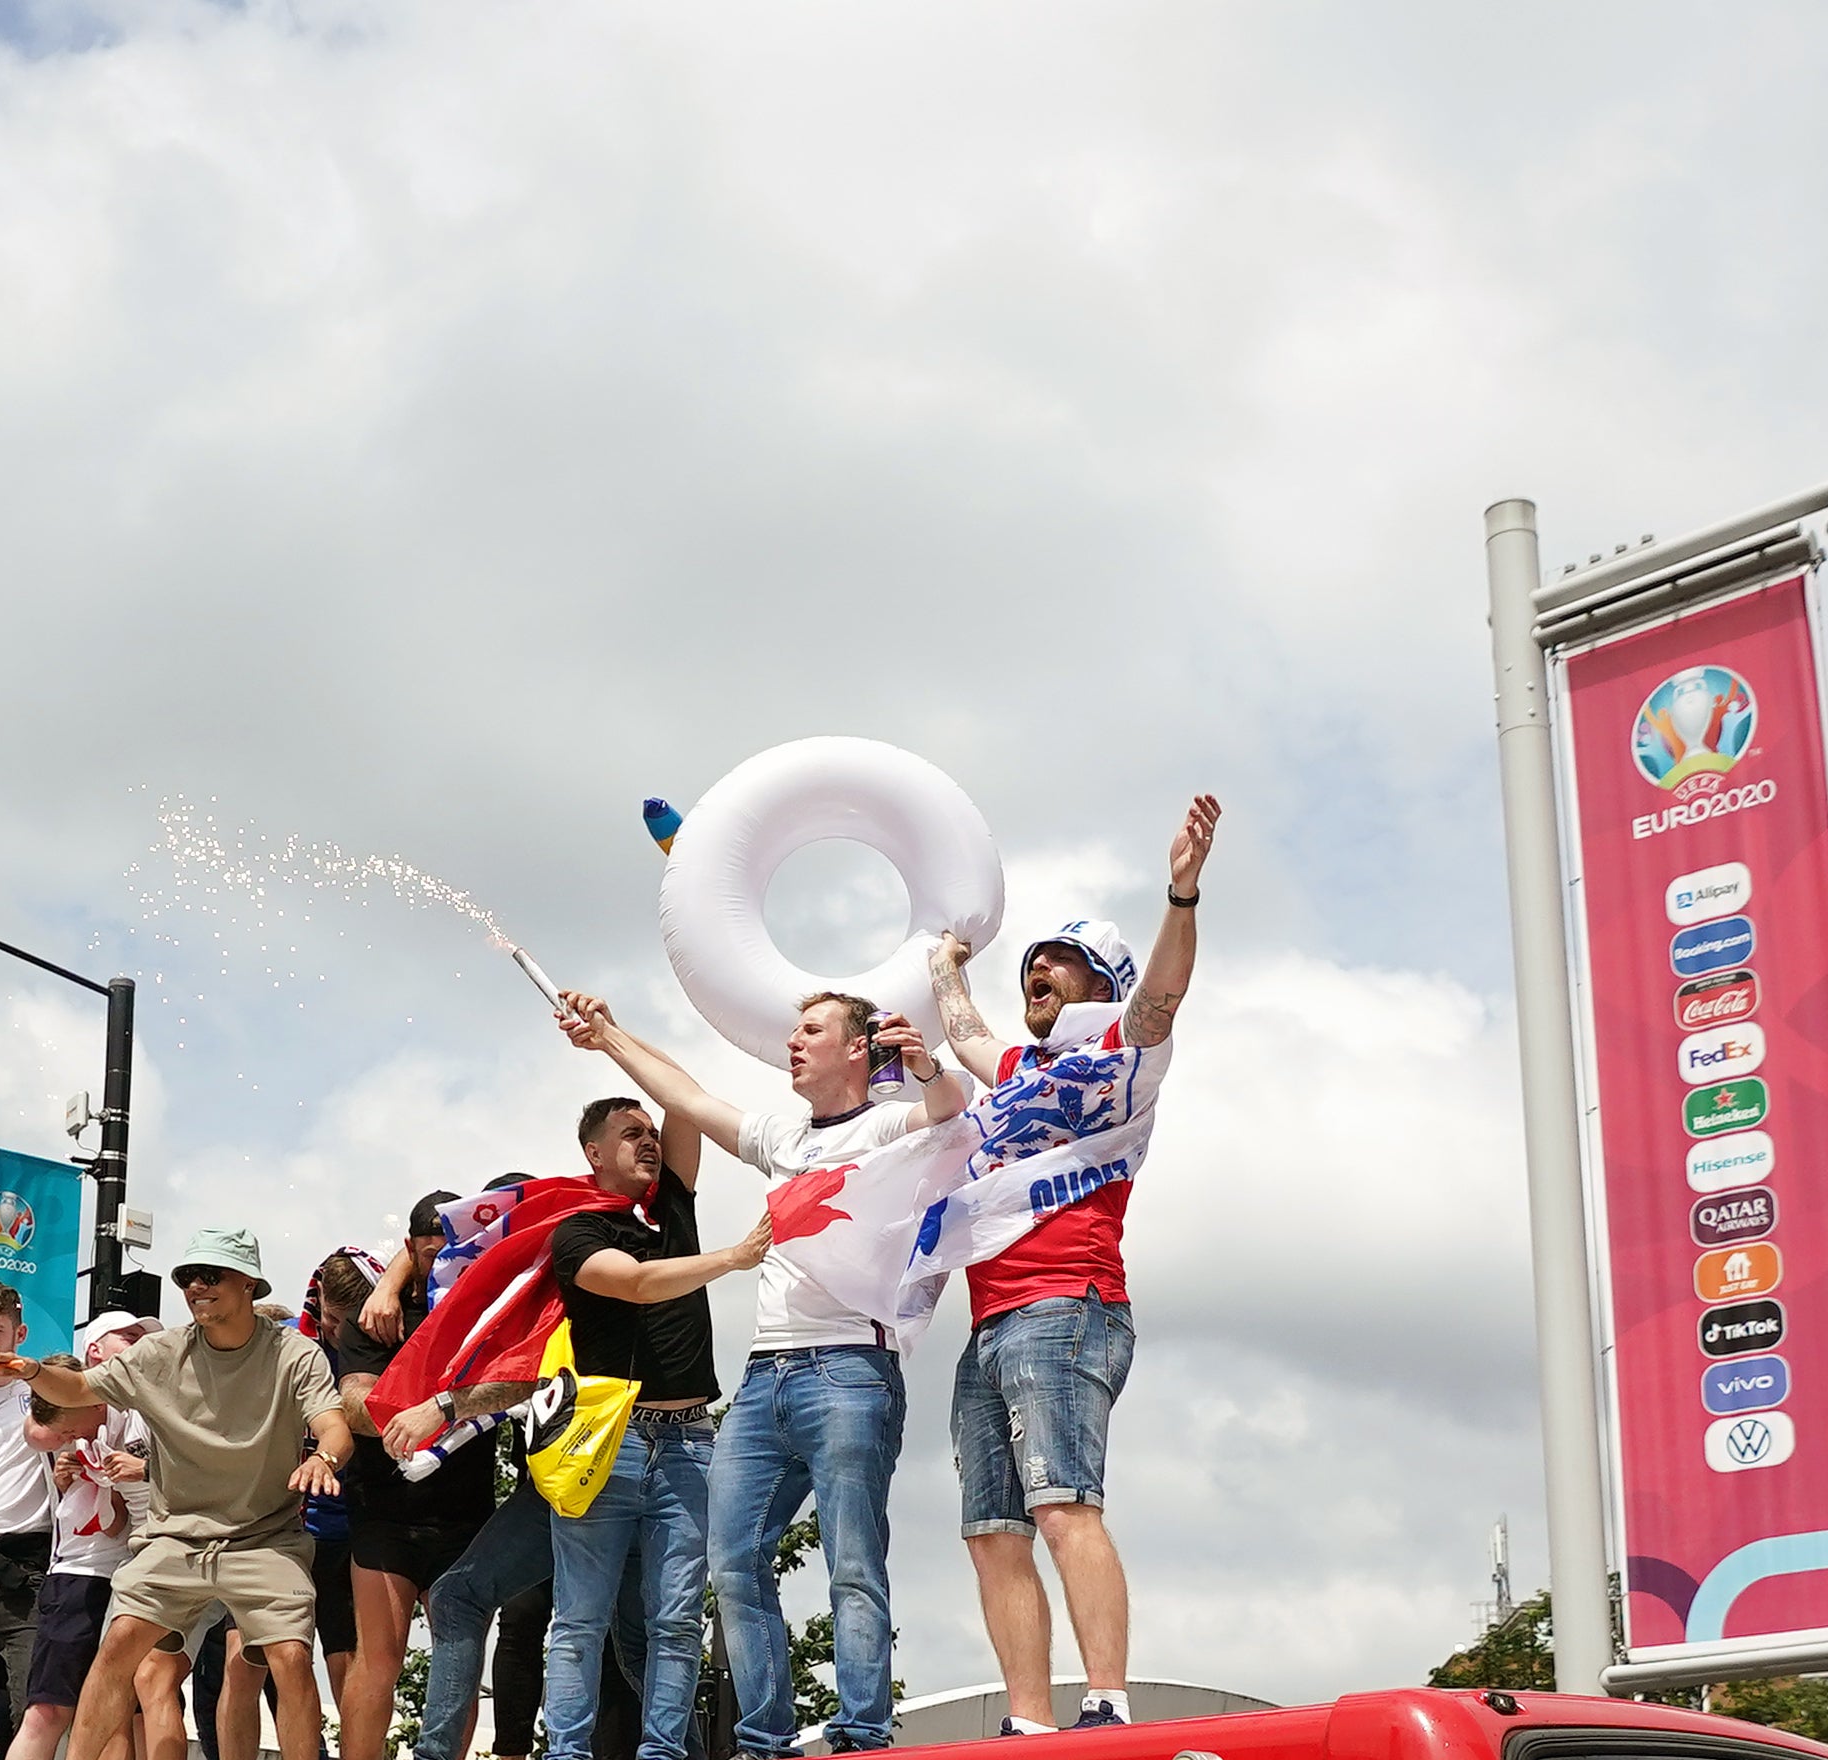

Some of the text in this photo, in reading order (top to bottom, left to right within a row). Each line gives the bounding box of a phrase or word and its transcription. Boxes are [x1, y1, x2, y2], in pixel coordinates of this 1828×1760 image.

[1673, 932, 1752, 961] Booking.com
[1689, 1041, 1752, 1069] FedEx
[1692, 1103, 1760, 1131] Heineken
[1692, 1150, 1767, 1175] Hisense
[1698, 1197, 1769, 1228] QATAR
[1715, 1212, 1771, 1234] AIRWAYS
[1722, 1317, 1780, 1341] TikTok
[1717, 1375, 1774, 1395] vivo
